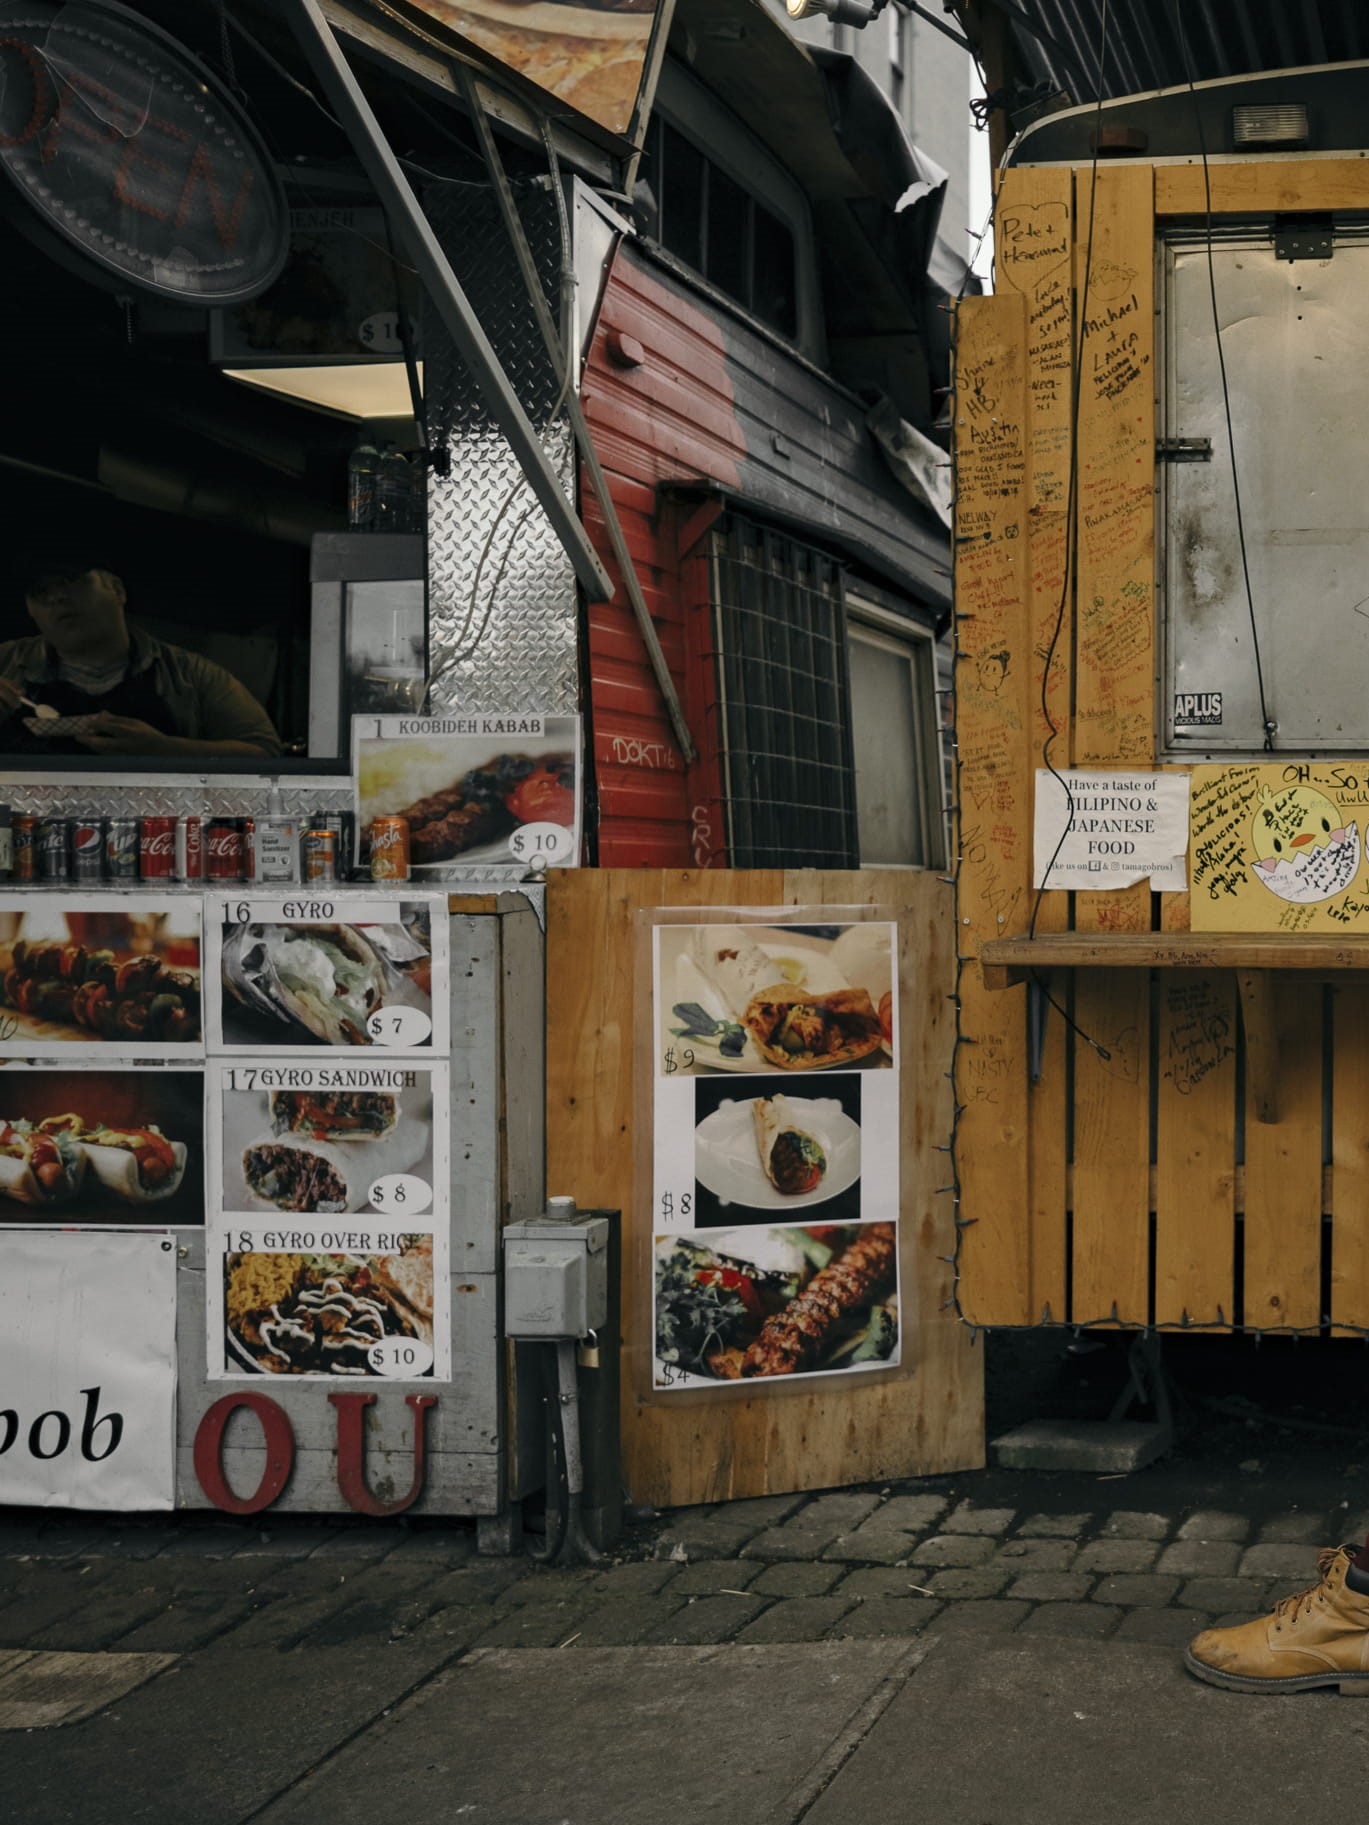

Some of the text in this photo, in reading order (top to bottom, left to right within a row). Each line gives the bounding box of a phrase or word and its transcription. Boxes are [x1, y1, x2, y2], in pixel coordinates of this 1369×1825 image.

[1083, 295, 1139, 338] Michael
[1175, 694, 1222, 717] APLUS
[399, 718, 477, 736] KOOBIDEH
[482, 717, 542, 735] KABAB
[1068, 779, 1158, 791] Have a taste of
[1146, 798, 1158, 812] &
[1068, 819, 1155, 833] JAPANESE
[513, 834, 558, 853] $ 10
[1088, 840, 1135, 855] FOOD
[1066, 862, 1076, 871] us
[1077, 862, 1088, 871] on
[221, 901, 335, 925] 16 GYRO
[371, 1016, 404, 1036] $ 7
[663, 1047, 696, 1075] $ 9
[227, 1069, 417, 1092] 17 GYRO SANDWICH
[371, 1184, 407, 1204] $ 8
[661, 1191, 693, 1221] $ 8
[223, 1231, 420, 1255] 18 GYRO OVER RICE
[371, 1347, 416, 1367] $ 10
[661, 1362, 691, 1387] $ 4
